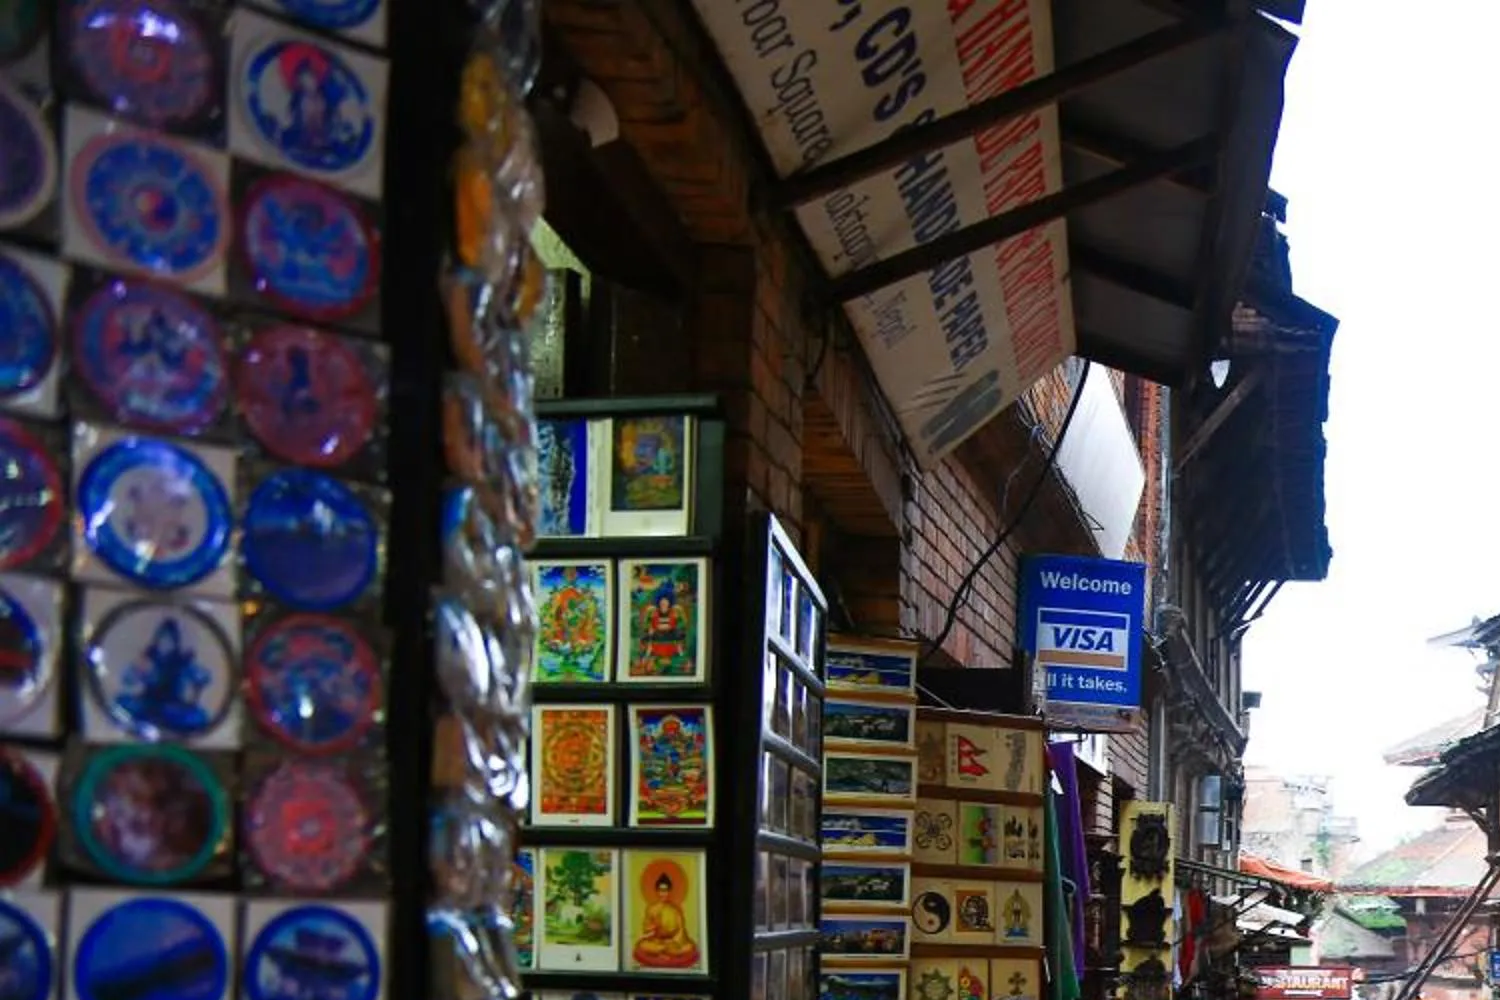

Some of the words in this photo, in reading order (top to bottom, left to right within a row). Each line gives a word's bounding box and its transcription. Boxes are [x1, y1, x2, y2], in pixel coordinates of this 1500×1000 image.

[893, 149, 973, 312] HANDADE
[935, 290, 988, 372] PAPER
[1039, 571, 1132, 595] Welcome
[1053, 626, 1114, 652] VISA
[1061, 673, 1074, 689] it
[1078, 675, 1128, 693] takes.
